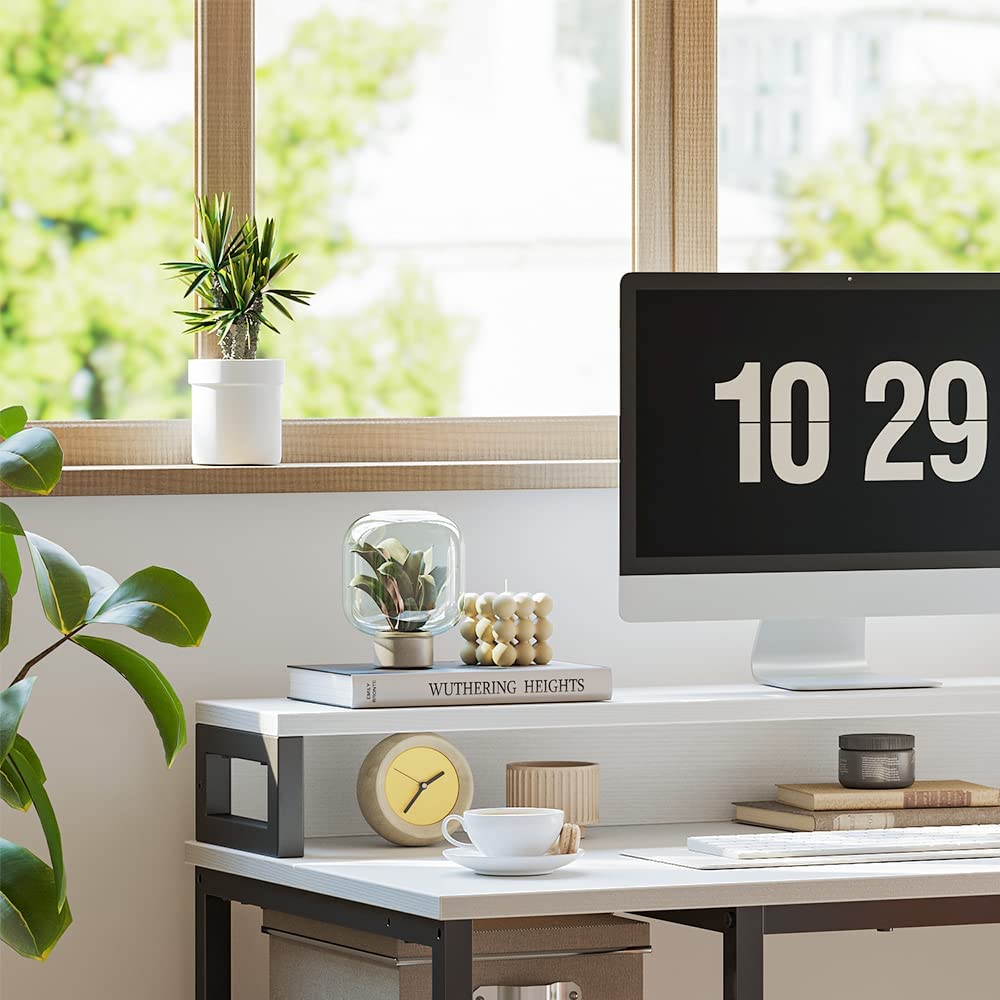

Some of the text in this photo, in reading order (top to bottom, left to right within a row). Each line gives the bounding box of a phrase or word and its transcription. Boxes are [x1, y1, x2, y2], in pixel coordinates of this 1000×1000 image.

[714, 360, 988, 485] 10 29
[428, 678, 585, 697] WUTHERING HEIGHTS
